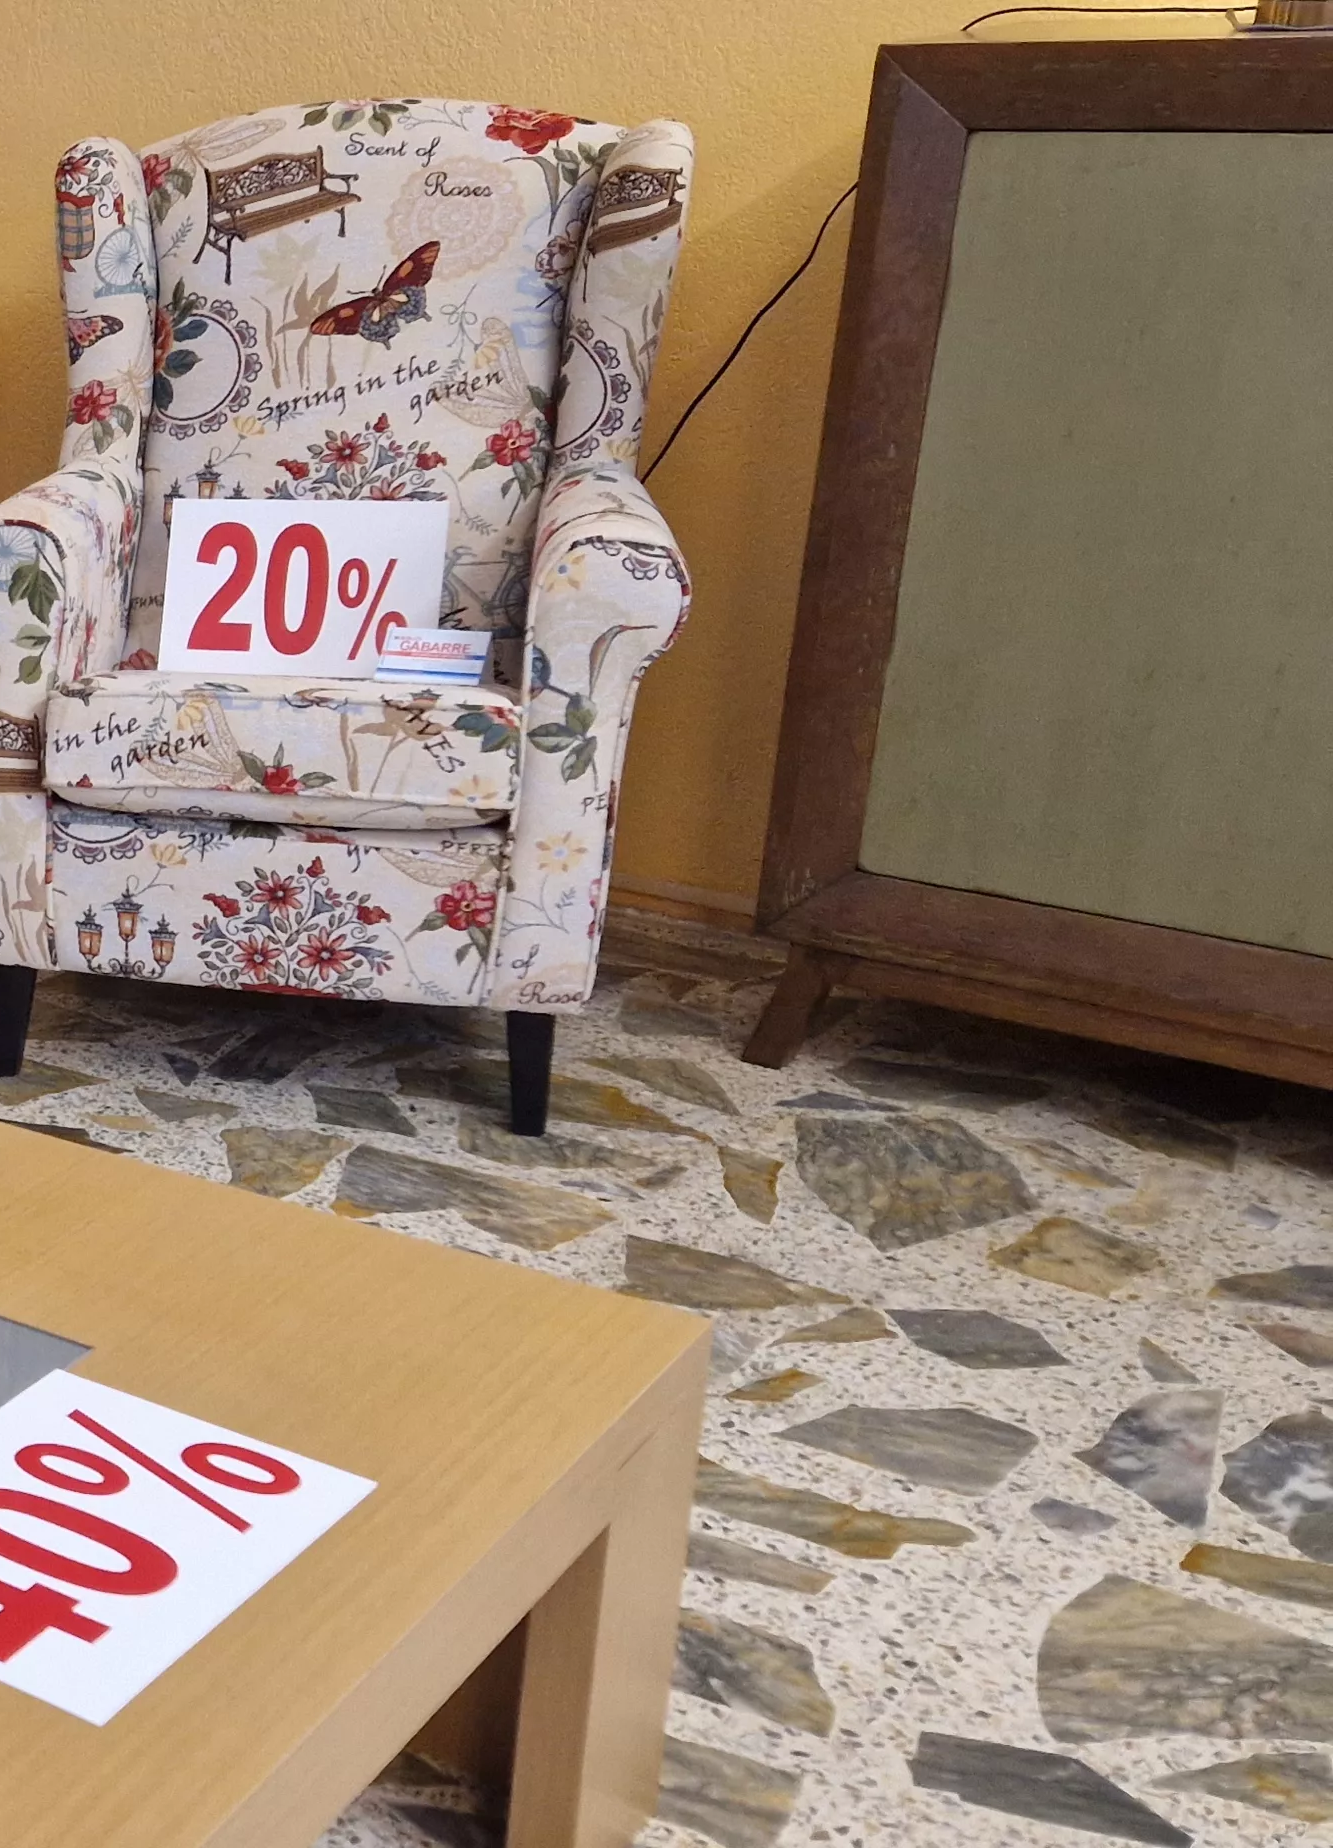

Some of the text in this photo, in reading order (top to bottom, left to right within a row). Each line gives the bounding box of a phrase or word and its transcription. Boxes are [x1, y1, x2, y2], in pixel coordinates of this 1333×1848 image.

[345, 132, 442, 168] Scent of
[424, 171, 493, 197] Roses
[257, 355, 441, 431] Spring in the
[409, 368, 504, 425] garden
[187, 522, 408, 660] 20%
[399, 640, 473, 654] GABARRE
[53, 711, 142, 754] in the
[110, 731, 210, 783] garden
[511, 943, 540, 980] of
